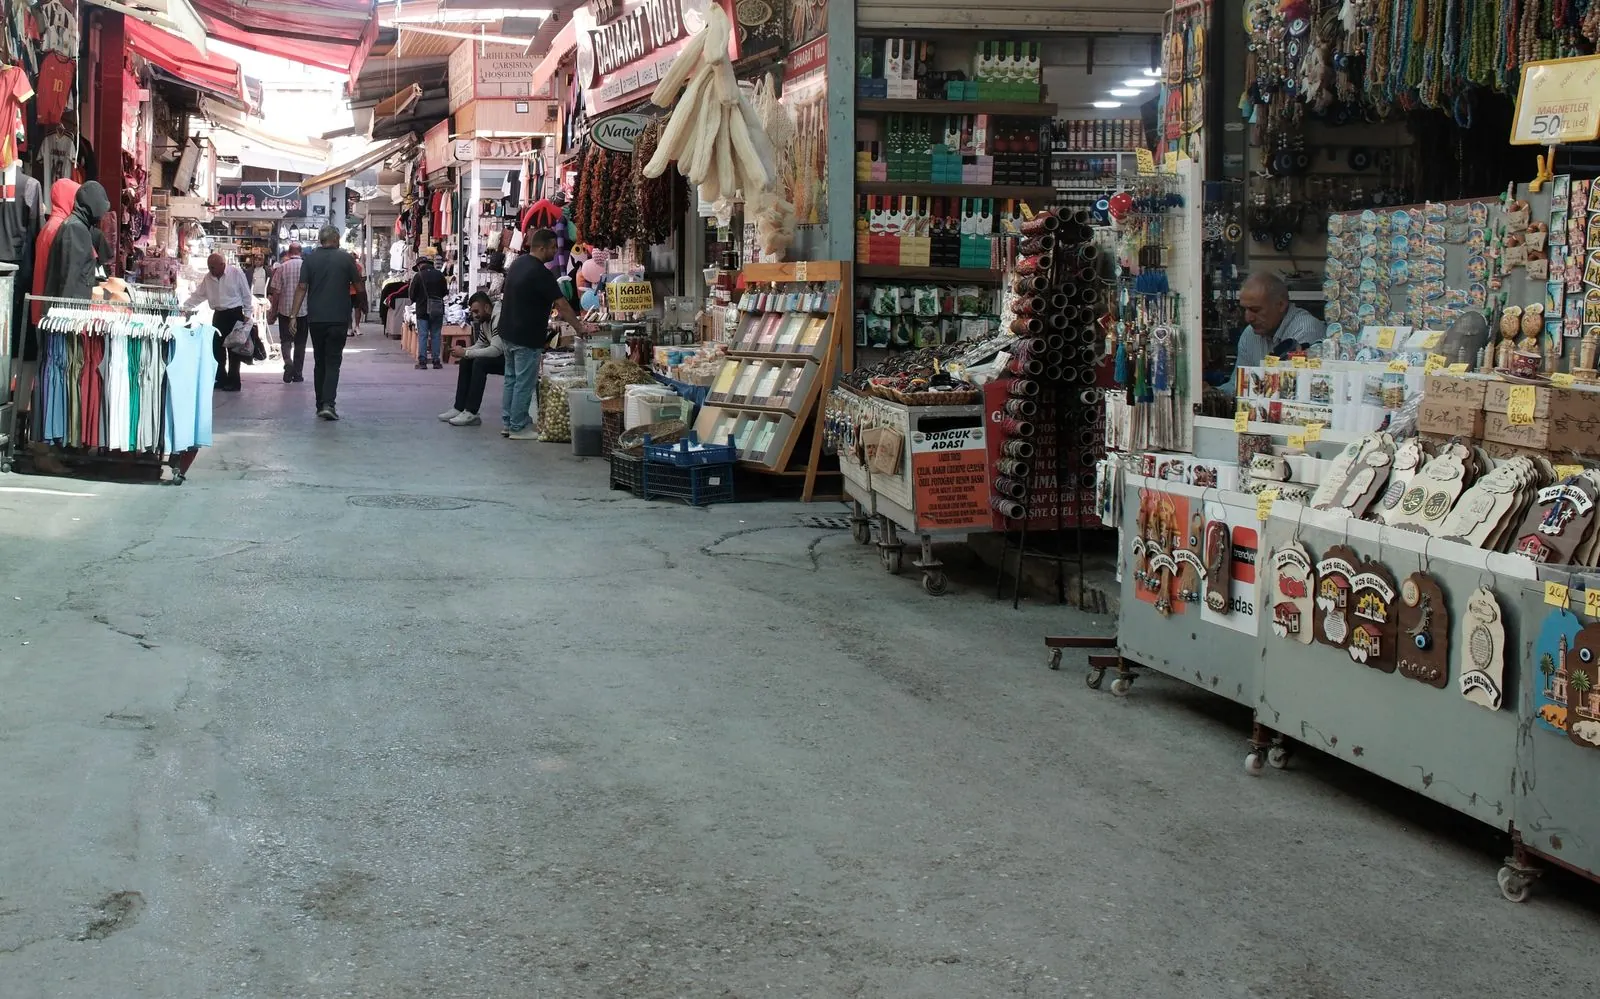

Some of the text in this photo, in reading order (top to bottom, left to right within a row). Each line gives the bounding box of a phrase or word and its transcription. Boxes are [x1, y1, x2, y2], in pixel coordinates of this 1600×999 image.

[53, 78, 63, 92] 10
[1536, 102, 1589, 115] MAGNETLER
[1531, 115, 1560, 135] 50
[217, 191, 256, 211] anta
[925, 430, 971, 441] BONCUK
[931, 440, 964, 450] ADASI
